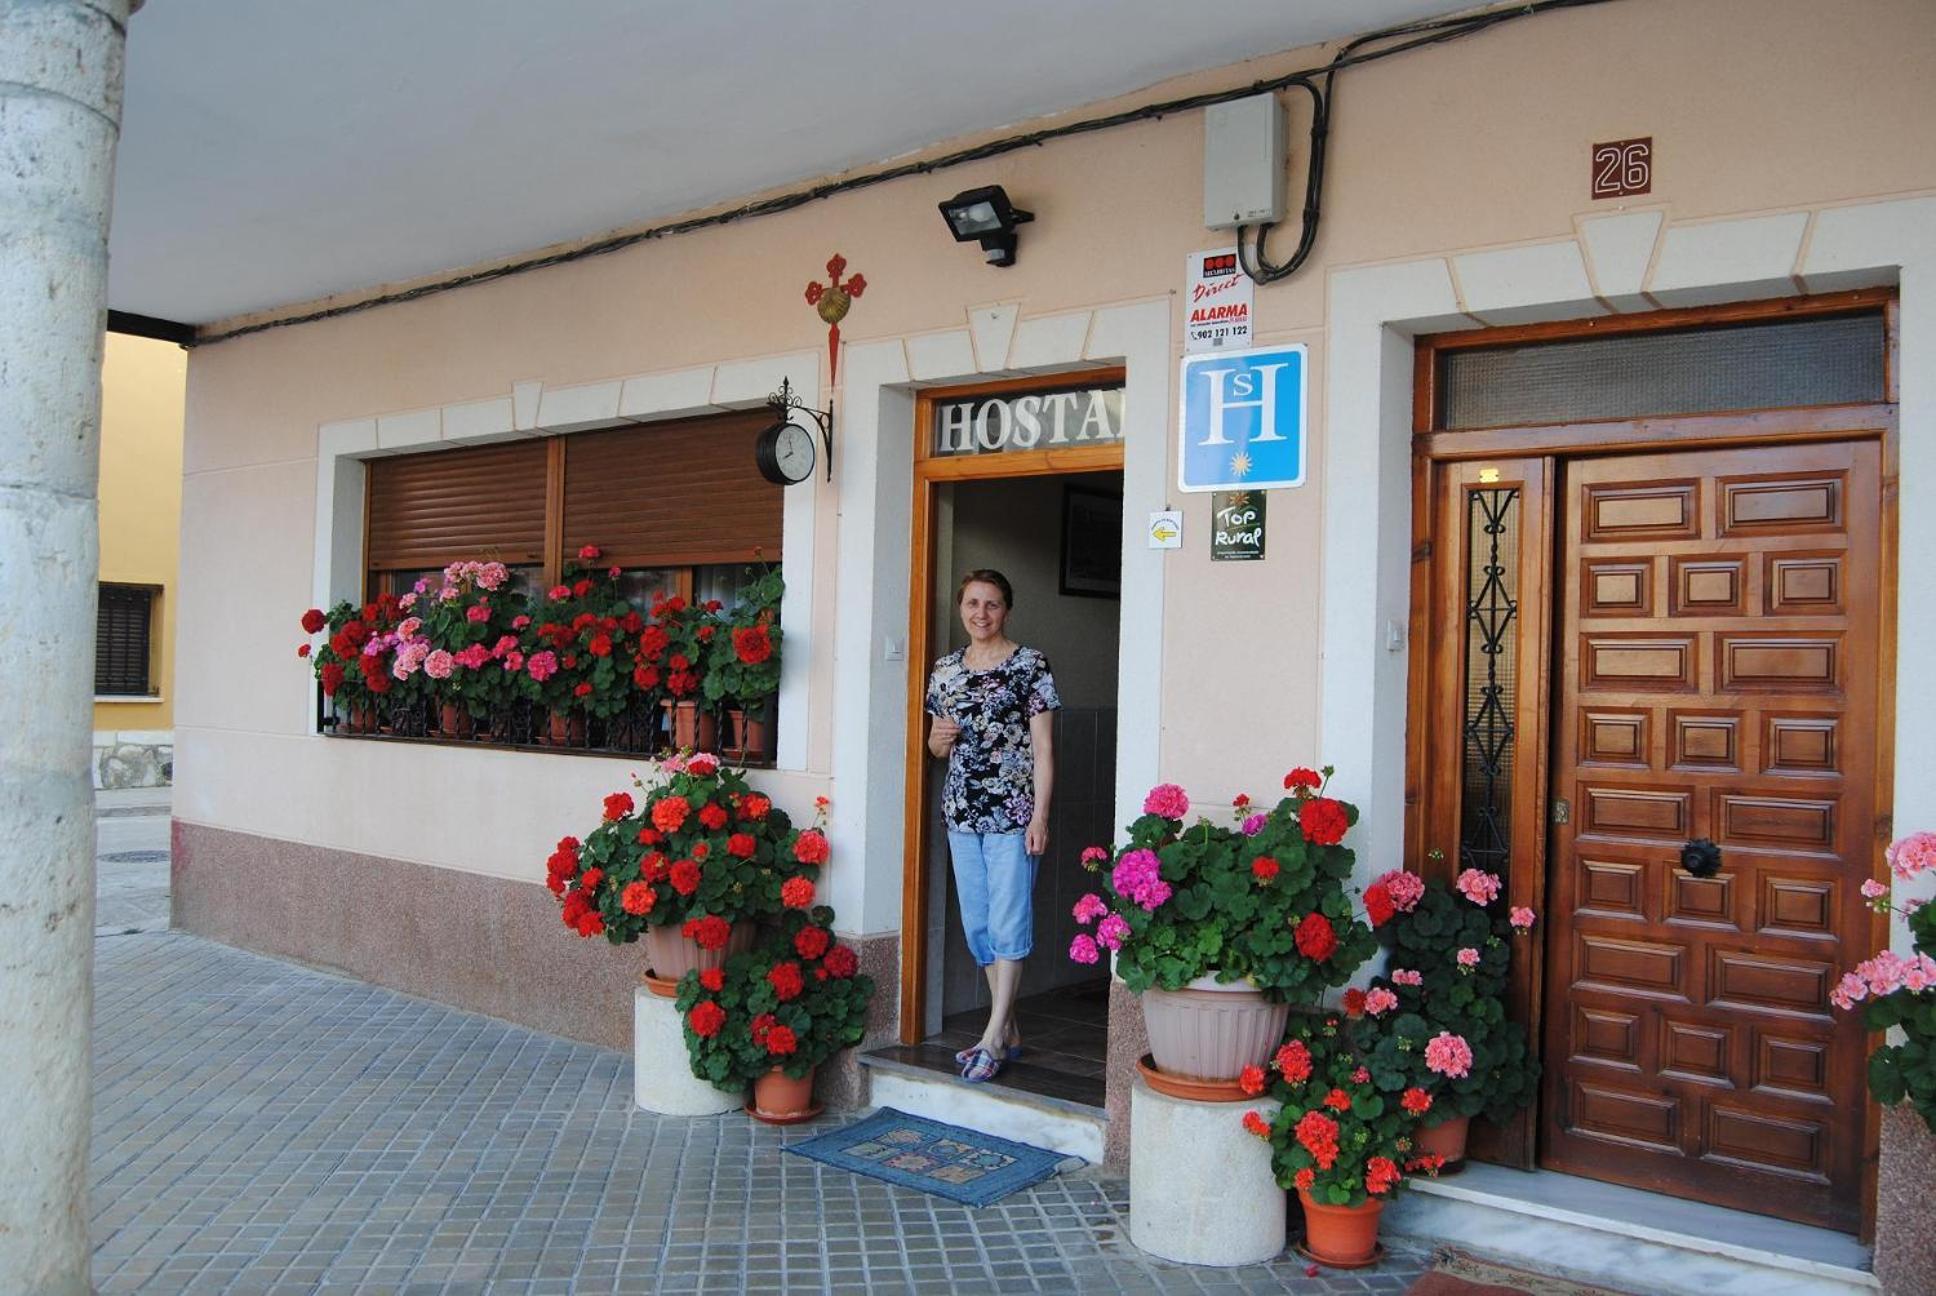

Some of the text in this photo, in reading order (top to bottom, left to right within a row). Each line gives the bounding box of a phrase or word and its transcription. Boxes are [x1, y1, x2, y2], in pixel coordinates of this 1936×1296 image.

[1595, 144, 1648, 193] 26
[1193, 273, 1245, 302] Direct
[1190, 303, 1248, 322] ALARMA
[1198, 326, 1247, 339] 902 121 122
[940, 388, 1126, 451] HOSTA
[1215, 528, 1262, 547] Rural
